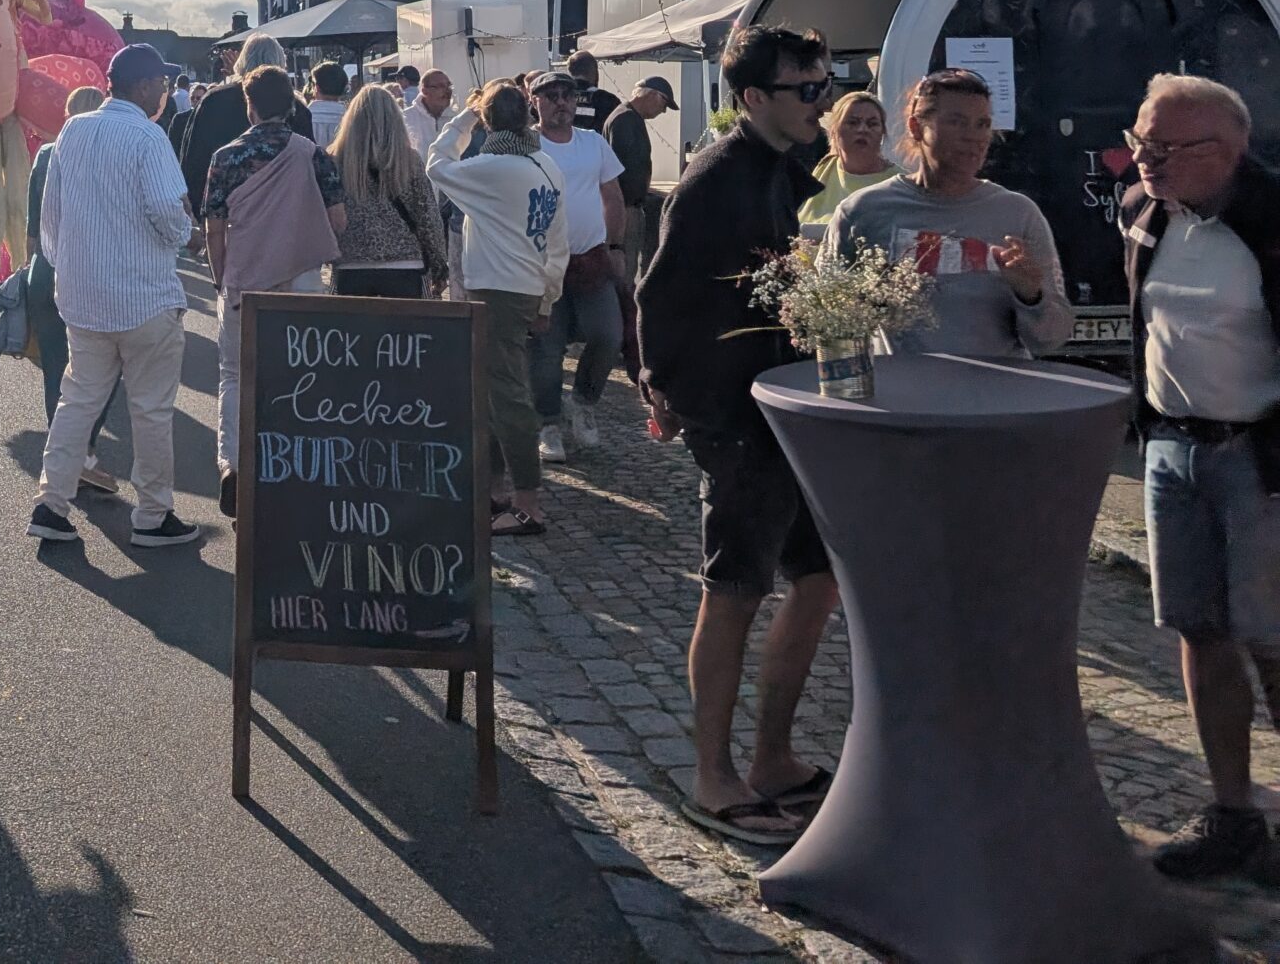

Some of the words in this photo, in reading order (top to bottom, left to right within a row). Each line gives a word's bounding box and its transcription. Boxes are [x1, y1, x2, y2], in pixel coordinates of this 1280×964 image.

[1084, 150, 1102, 175] I
[1083, 181, 1127, 223] Syl
[287, 325, 360, 367] BOCK
[376, 333, 432, 369] AUF
[271, 372, 447, 428] lecker
[257, 431, 462, 501] BURGER
[329, 500, 390, 536] UND
[299, 540, 463, 596] VINO?
[271, 595, 327, 632] HIER
[344, 598, 408, 634] LANG
